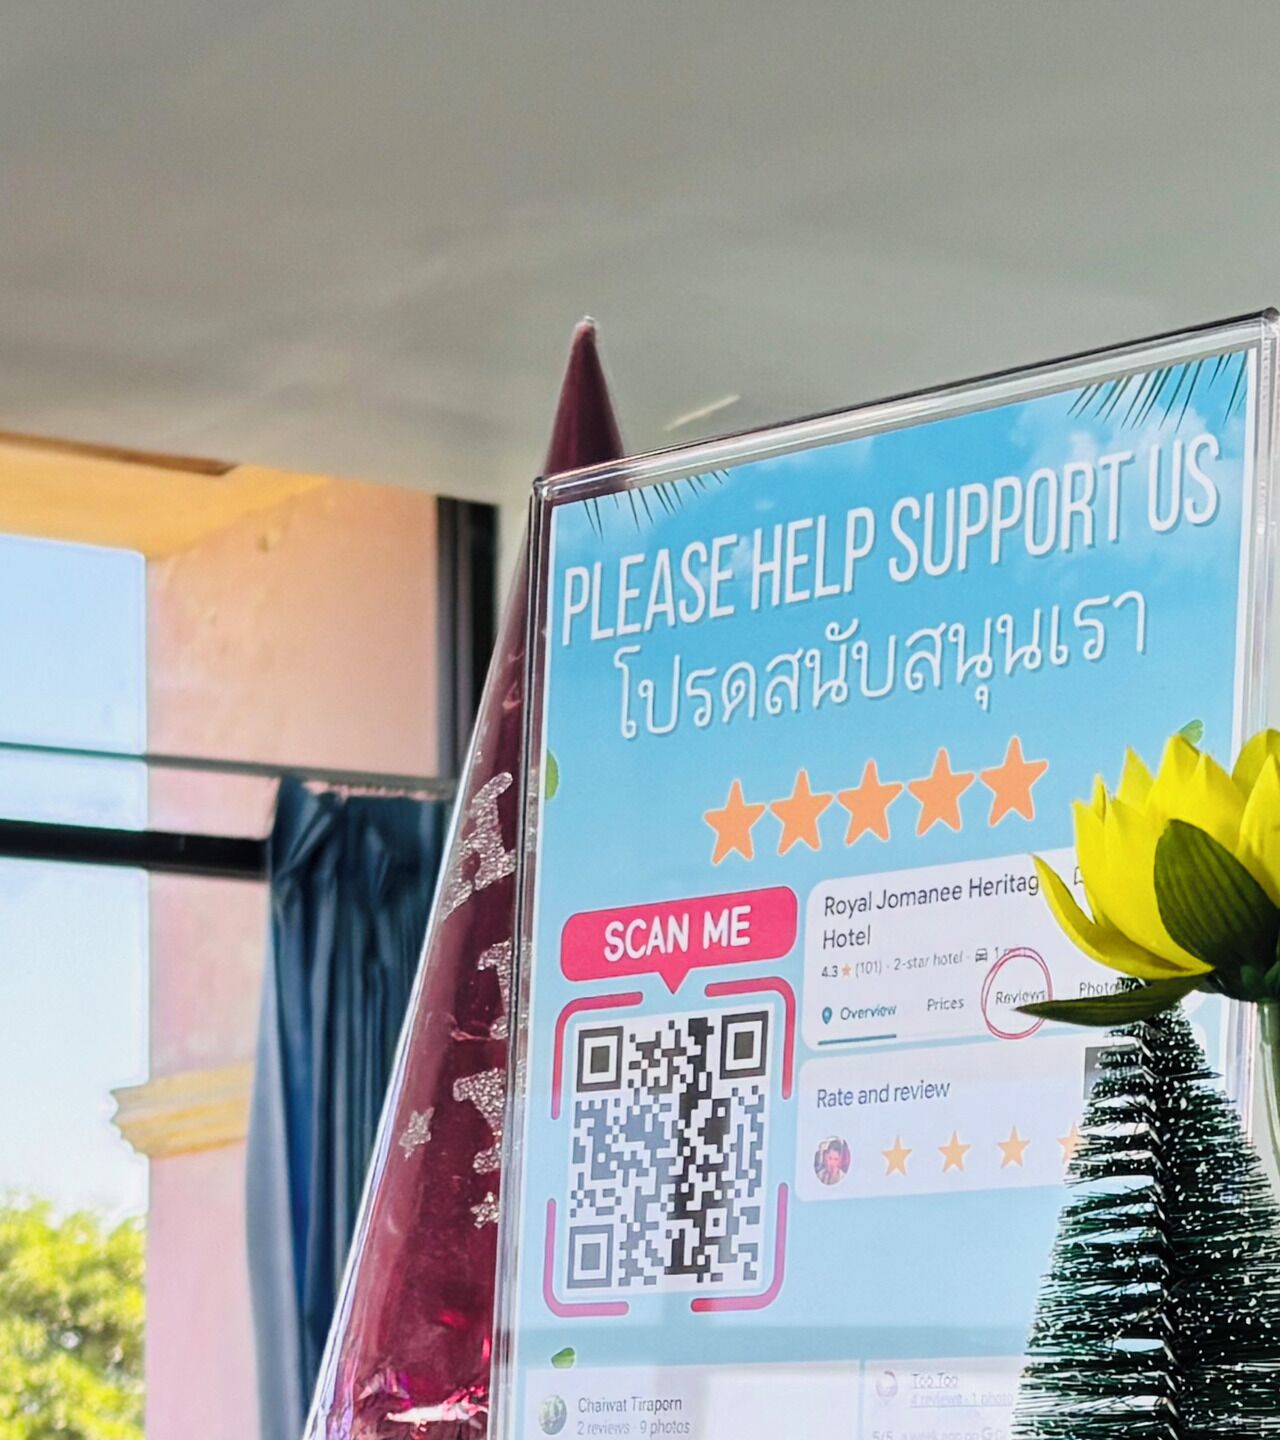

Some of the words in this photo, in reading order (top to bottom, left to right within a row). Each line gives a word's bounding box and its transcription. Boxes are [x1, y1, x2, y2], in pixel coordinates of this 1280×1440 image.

[561, 534, 738, 646] PLEASE
[750, 506, 876, 612] HELP
[887, 452, 1134, 584] SUPPORT
[1147, 432, 1220, 534] US
[614, 589, 1147, 740] โปรดสนับสนุนเรา
[824, 890, 872, 919] Royal
[876, 880, 962, 911] Jomanee
[969, 873, 1040, 898] Heritag
[603, 913, 689, 962] SCAN
[702, 905, 751, 949] ME
[822, 924, 871, 951] Hotel
[821, 965, 839, 978] 4.3
[855, 961, 882, 978] (101)
[893, 955, 929, 971] 2-star
[932, 950, 963, 967] hotel
[840, 1004, 897, 1021] Overview
[927, 996, 965, 1012] Prices
[817, 1087, 856, 1109] Rate
[858, 1083, 890, 1106] and
[893, 1079, 950, 1103] review
[578, 1397, 627, 1413] Chaiwat
[630, 1396, 682, 1415] Tiraporn
[577, 1421, 585, 1435] 2
[587, 1421, 630, 1435] reviews
[640, 1420, 647, 1434] 9
[649, 1419, 690, 1438] photos
